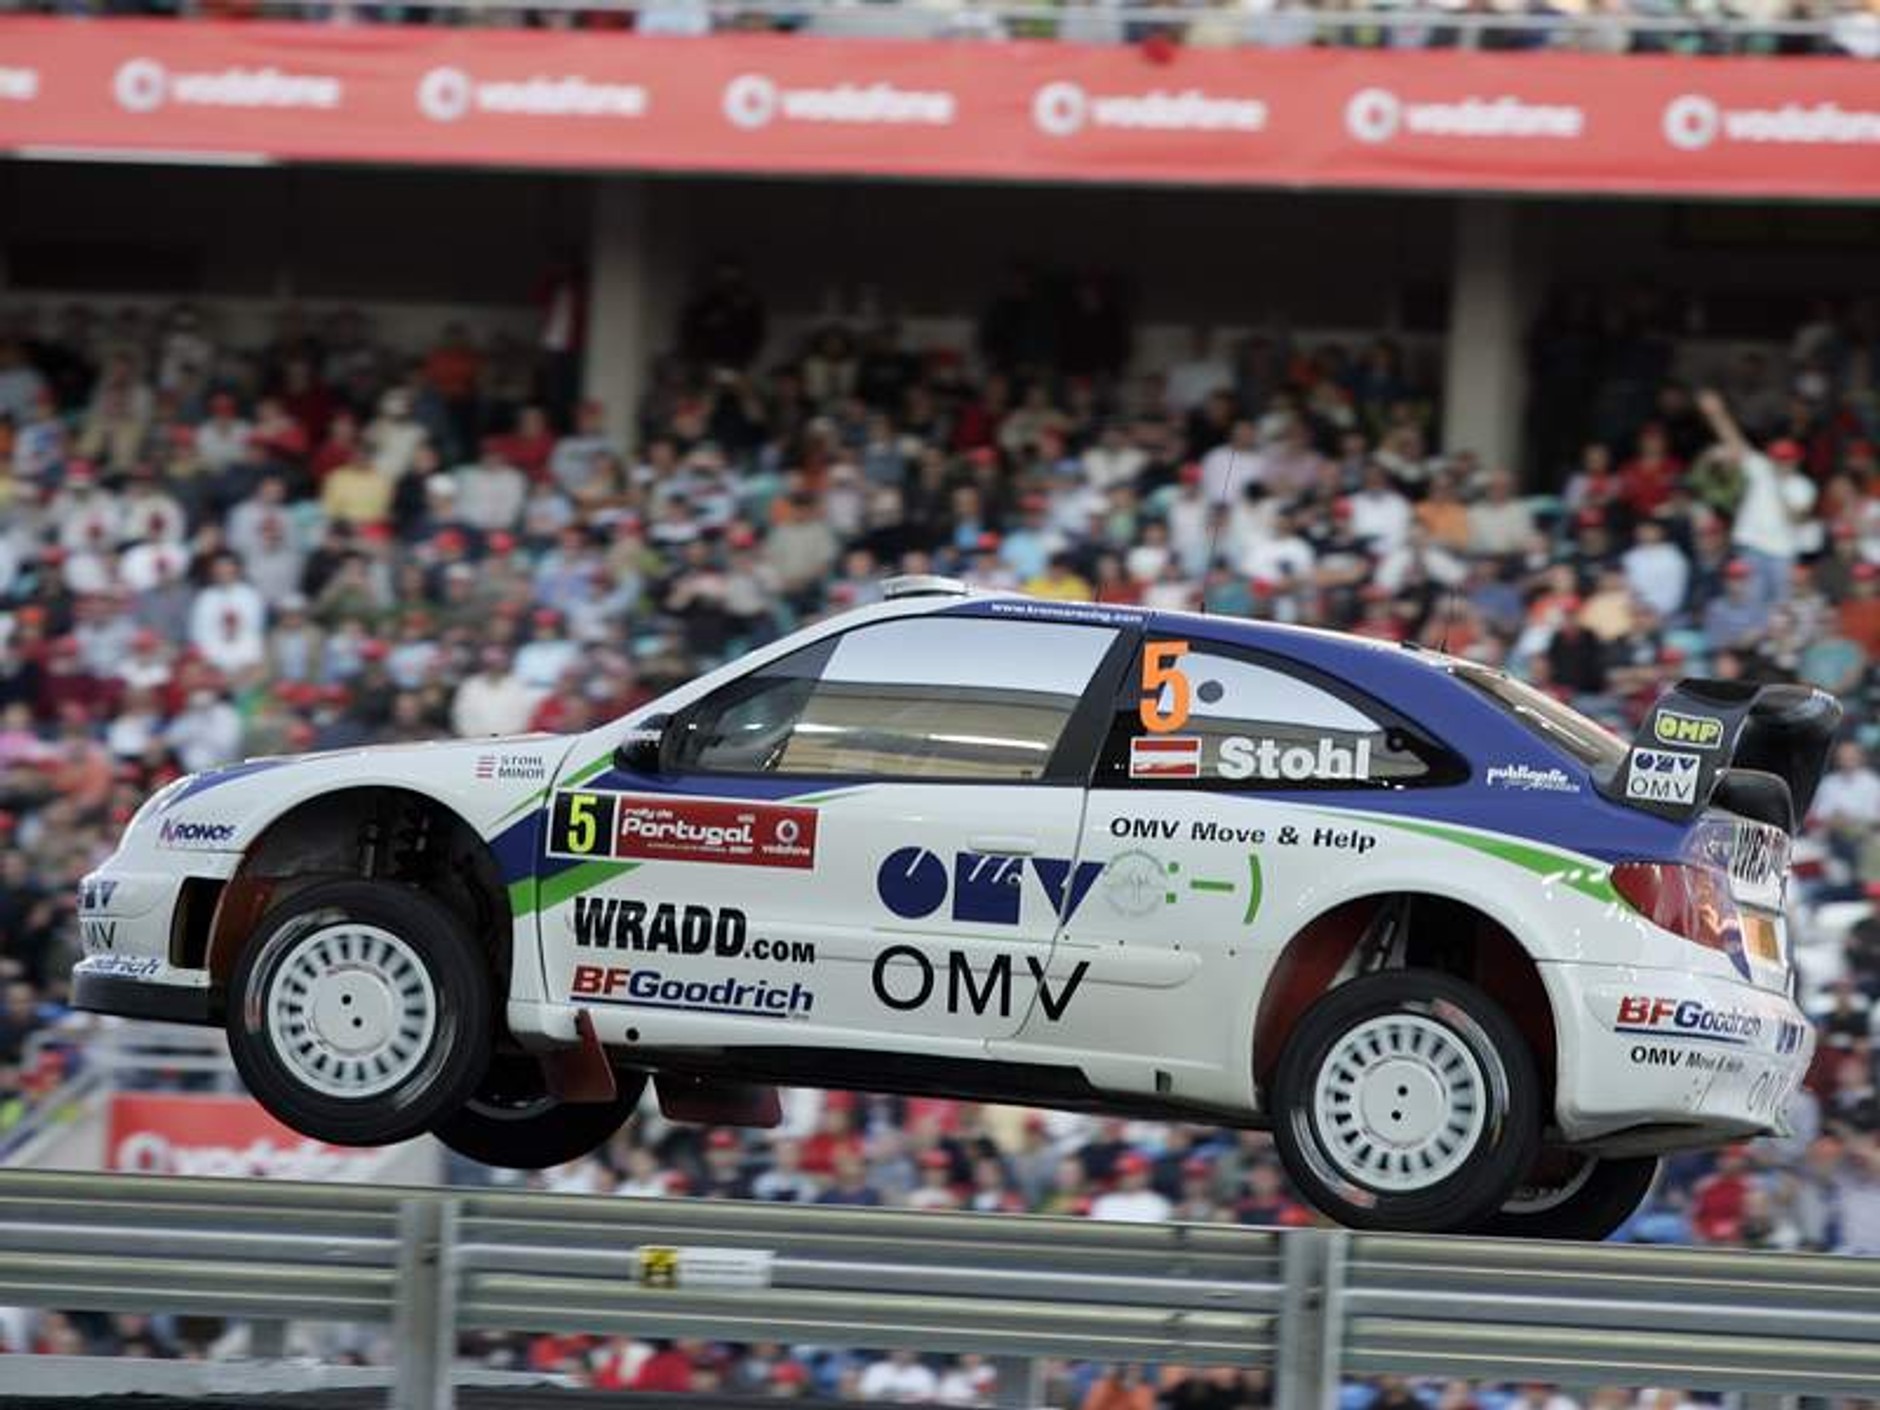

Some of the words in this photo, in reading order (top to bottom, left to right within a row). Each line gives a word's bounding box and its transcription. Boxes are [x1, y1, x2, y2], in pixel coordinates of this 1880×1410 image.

[1140, 641, 1191, 733] 5
[1658, 716, 1719, 742] OMP
[1217, 736, 1371, 780] Stohl
[1631, 776, 1691, 799] OMV
[160, 819, 237, 842] KRONOS
[567, 794, 597, 853] 5
[621, 817, 754, 845] Portugal
[1110, 817, 1181, 839] OMV
[1190, 821, 1266, 843] Move
[1276, 825, 1300, 846] &
[1313, 827, 1377, 854] Help
[570, 965, 815, 1014] BFGoodrich
[871, 944, 1091, 1022] OMV
[1630, 1045, 1682, 1067] OMV
